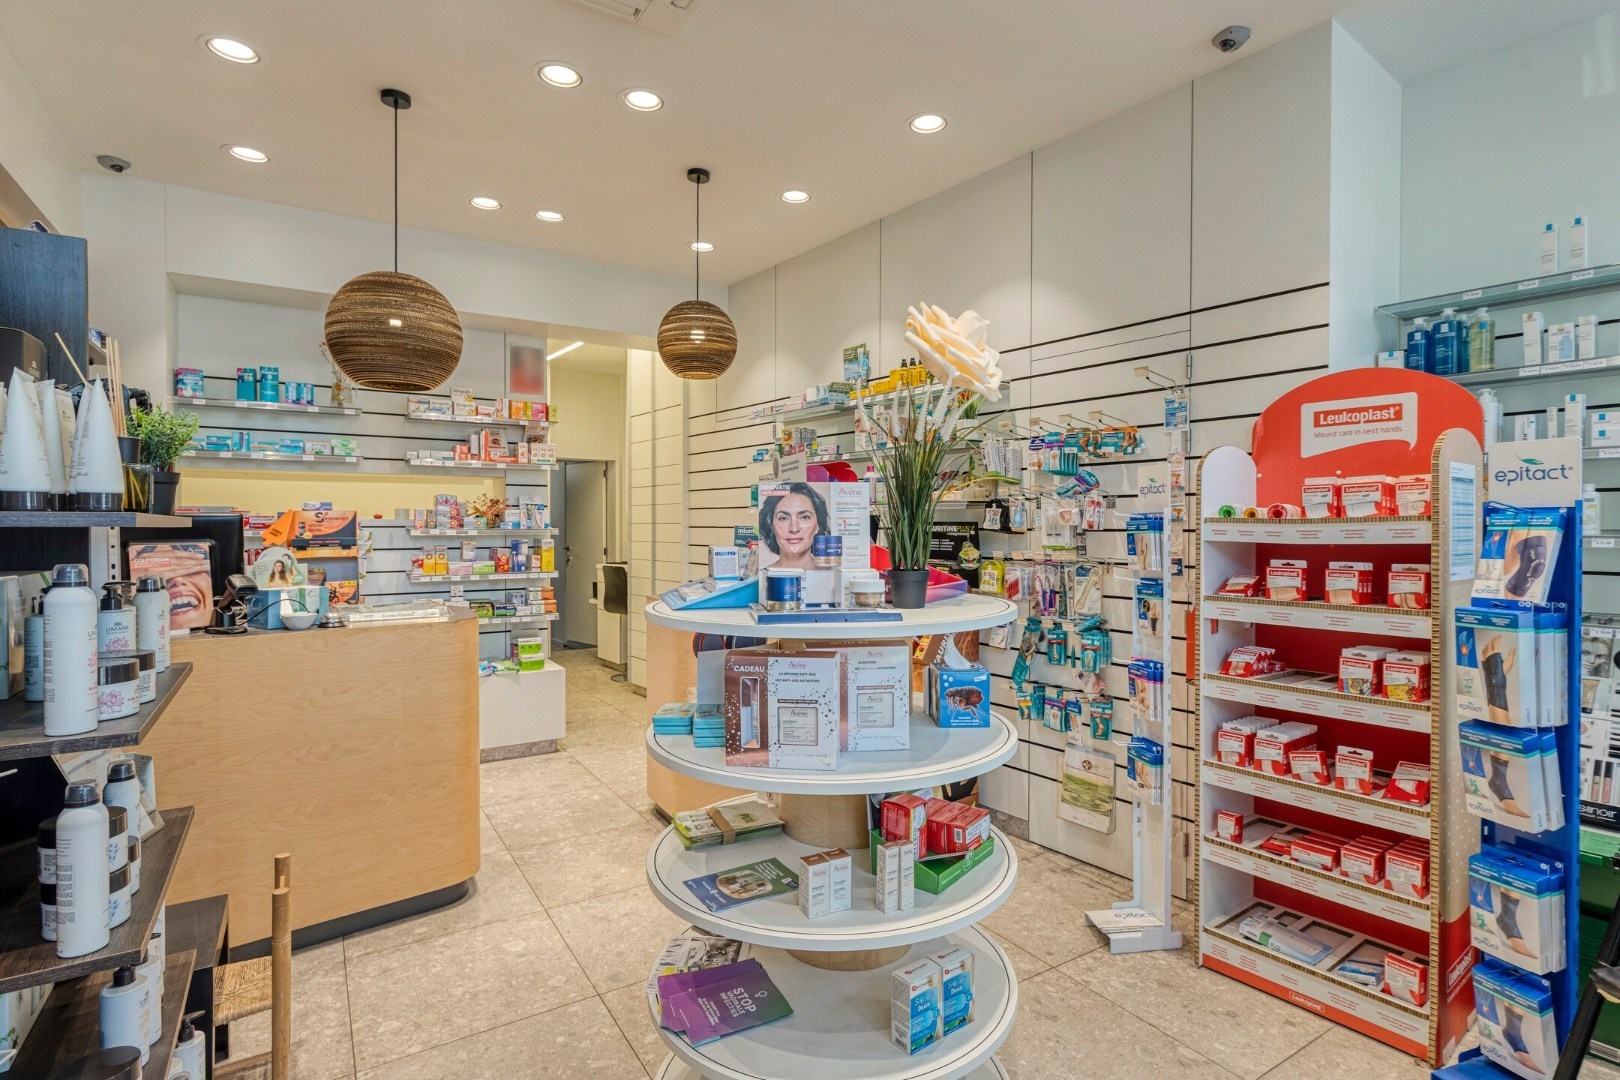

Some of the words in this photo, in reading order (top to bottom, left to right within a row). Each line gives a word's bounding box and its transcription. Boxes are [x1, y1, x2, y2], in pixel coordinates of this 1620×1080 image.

[1313, 430, 1337, 439] Wound
[1363, 427, 1378, 435] best
[1380, 425, 1402, 433] hands
[1495, 464, 1569, 486] epitact
[838, 487, 862, 496] Avène
[1140, 484, 1166, 497] epitact
[733, 665, 765, 673] CADEAU
[790, 709, 809, 717] Avène
[720, 992, 739, 1018] INFECTIES
[726, 990, 746, 1015] VAGINALE
[733, 987, 757, 1012] STOP
